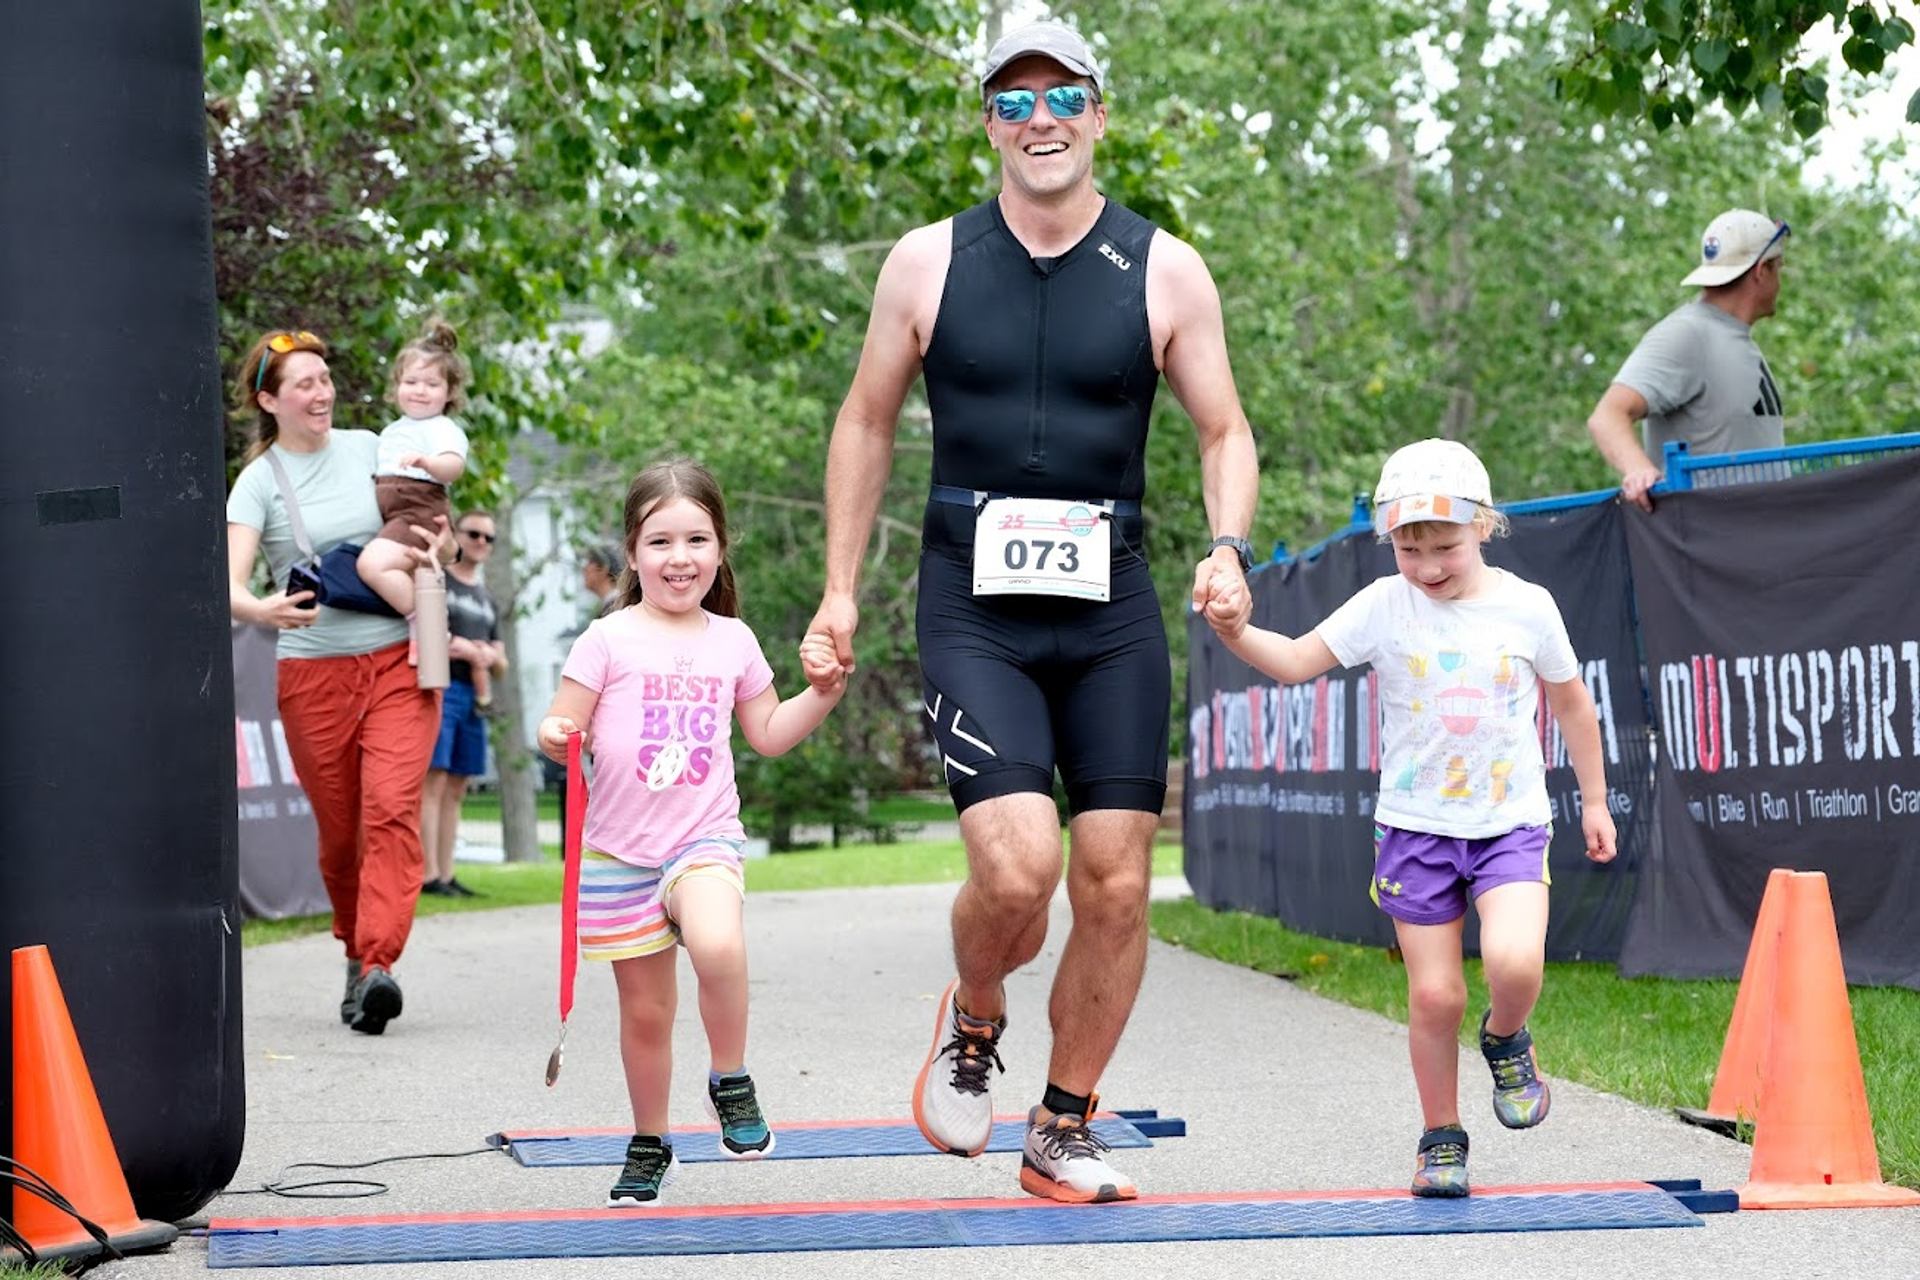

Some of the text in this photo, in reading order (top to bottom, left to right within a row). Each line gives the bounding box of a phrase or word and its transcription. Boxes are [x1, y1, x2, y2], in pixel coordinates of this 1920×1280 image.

[1098, 243, 1130, 270] 2XU
[1003, 514, 1024, 529] 25
[1004, 539, 1080, 572] 073
[642, 673, 723, 703] BEST
[640, 703, 718, 743] BIG
[1717, 792, 1746, 822] Bike
[1761, 790, 1789, 821] Run
[1807, 787, 1868, 819] Triathlon
